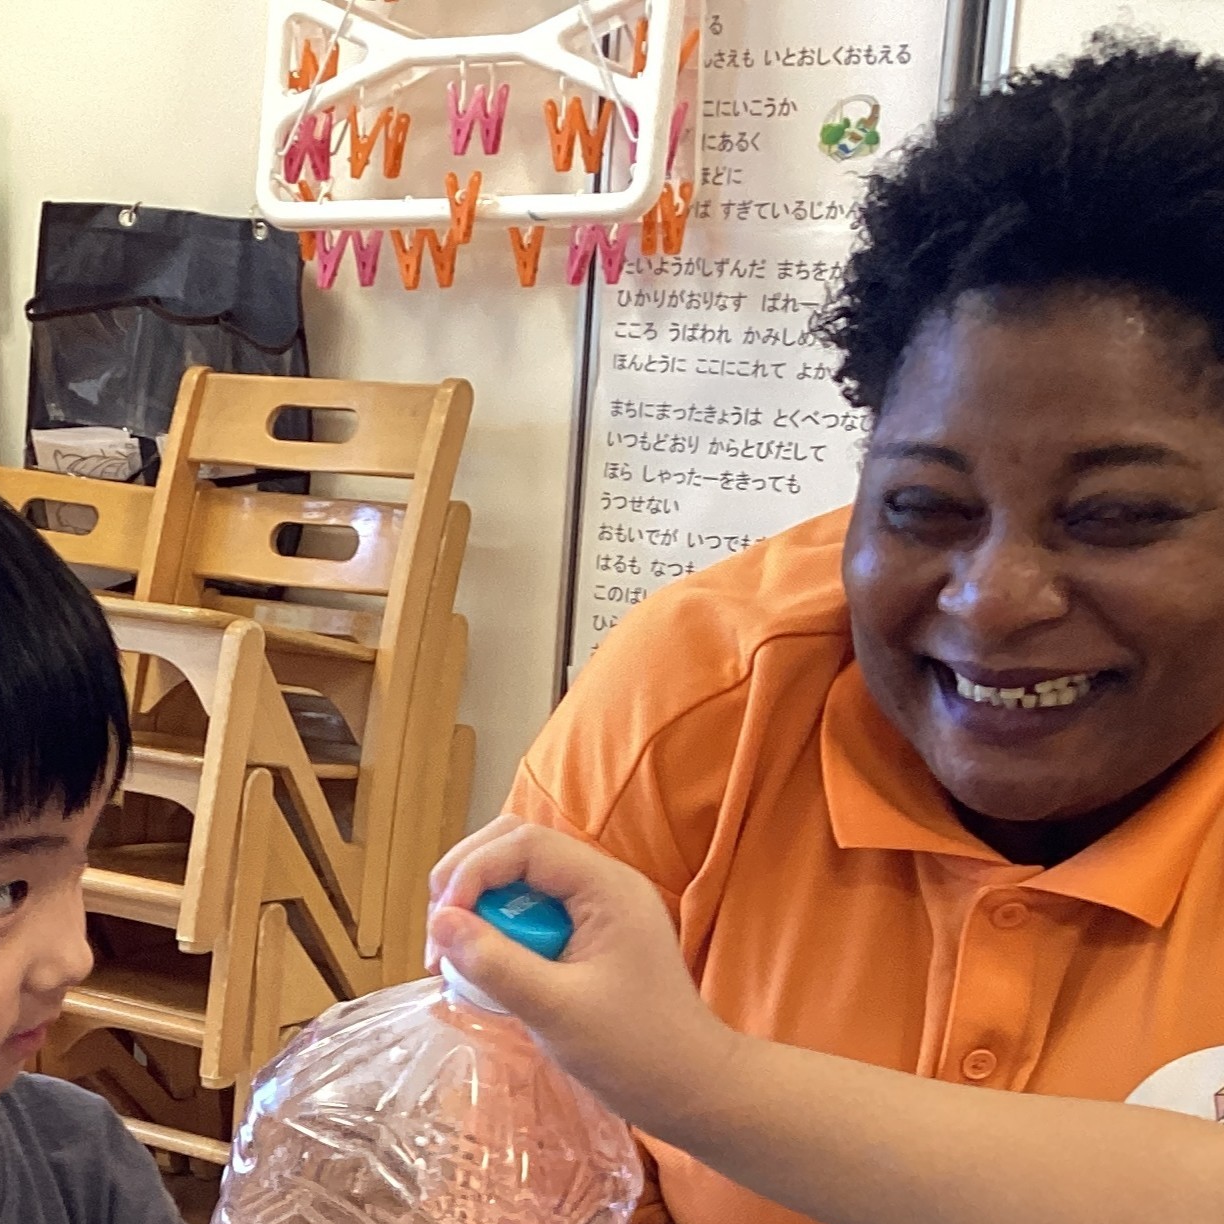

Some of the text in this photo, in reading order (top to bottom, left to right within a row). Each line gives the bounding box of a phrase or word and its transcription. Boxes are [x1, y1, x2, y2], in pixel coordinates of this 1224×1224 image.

[709, 15, 723, 36] る
[764, 44, 912, 68] いとおしくおもえる
[701, 132, 761, 152] にあるく
[617, 289, 747, 312] ひかりがおりなす
[615, 322, 657, 341] こころ
[669, 322, 731, 343] うばわれ
[613, 353, 687, 374] ほんとうに
[695, 358, 786, 379] ここにこれて
[610, 399, 763, 427] まちにまったきょうは
[607, 431, 827, 463] いつもどおり からとびだして
[604, 462, 801, 495] ほら しゃったーをきっても
[601, 492, 679, 515] うつせない
[598, 523, 766, 553] おもいでが いつでも
[596, 554, 641, 575] はるも
